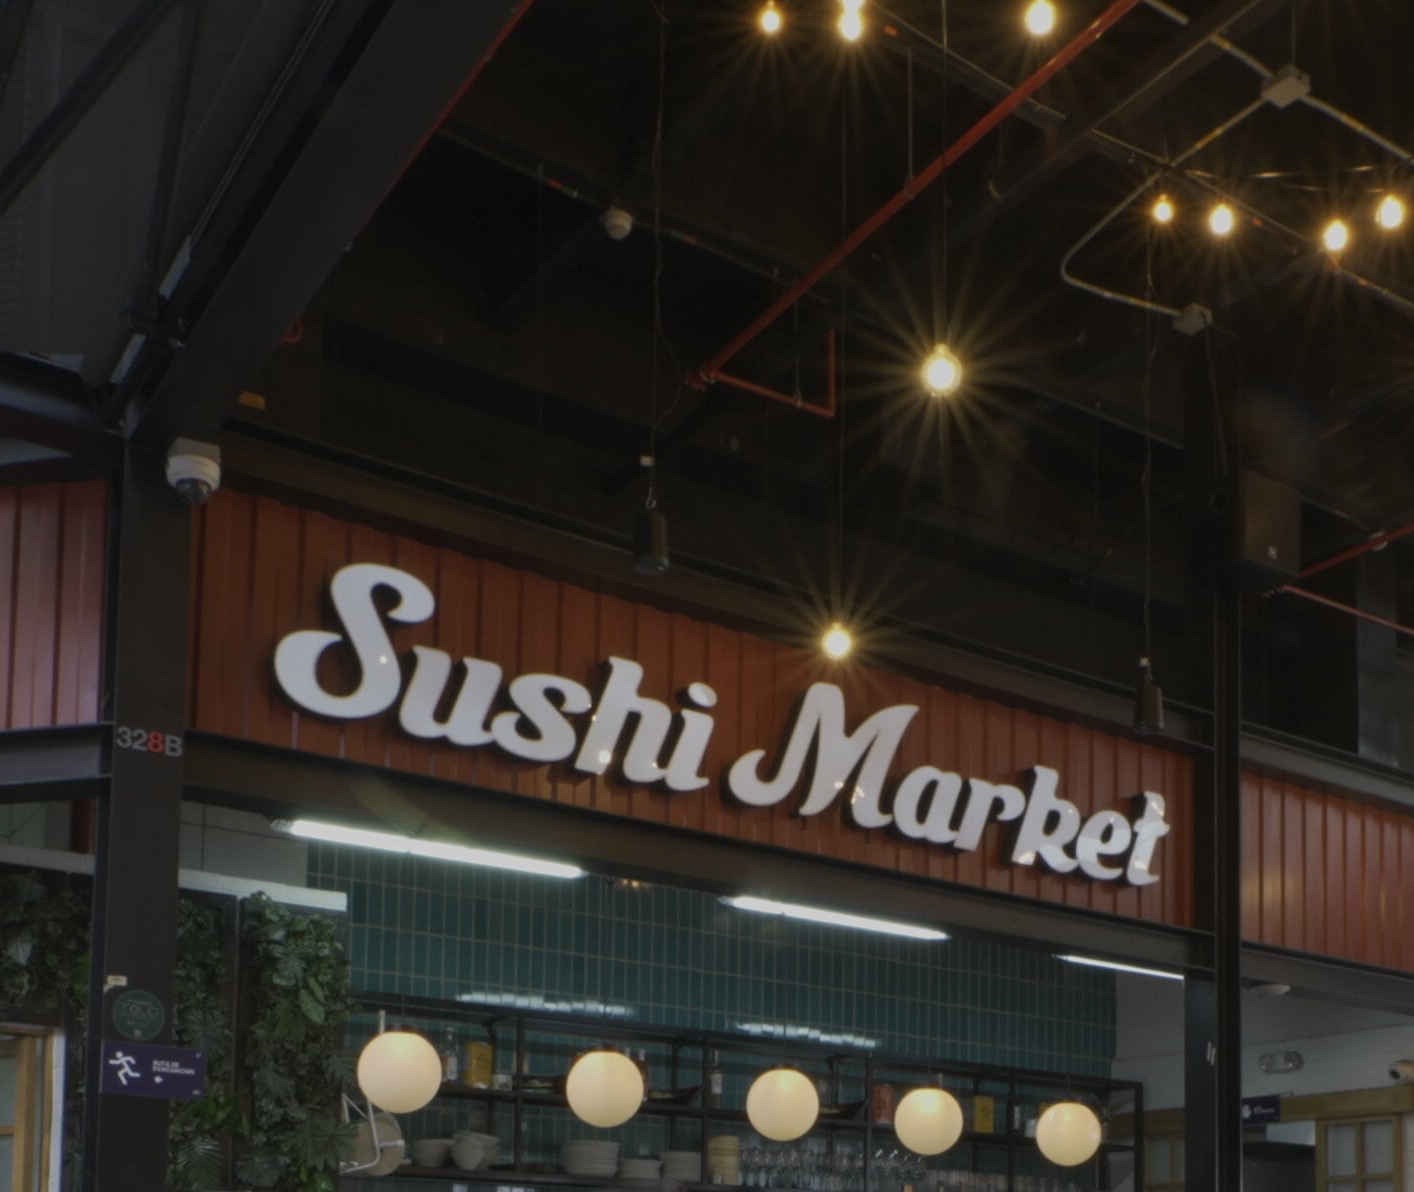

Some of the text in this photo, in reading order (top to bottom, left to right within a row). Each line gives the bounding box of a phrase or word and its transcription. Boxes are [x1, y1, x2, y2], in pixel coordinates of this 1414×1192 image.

[115, 726, 184, 758] 328B
[273, 563, 1171, 887] Sushi Market
